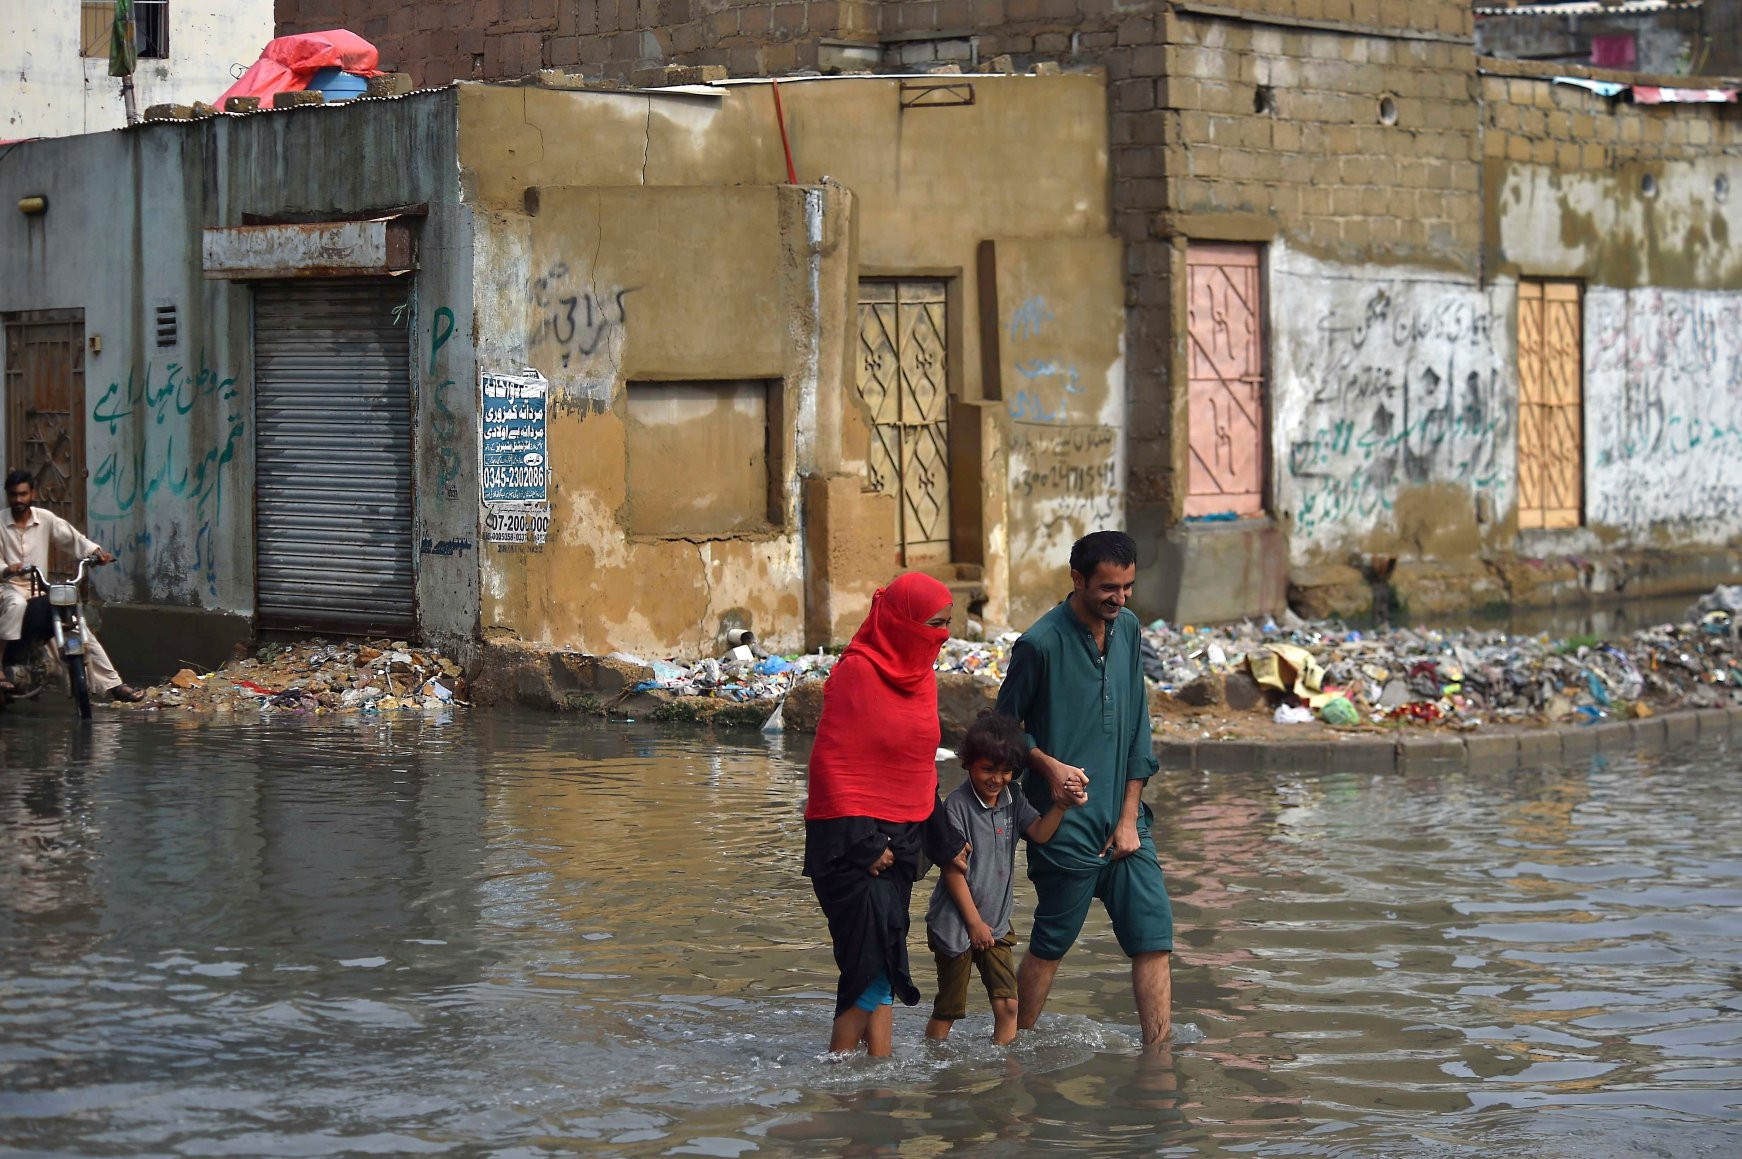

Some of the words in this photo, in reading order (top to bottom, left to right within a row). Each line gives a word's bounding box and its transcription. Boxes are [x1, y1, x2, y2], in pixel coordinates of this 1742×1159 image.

[485, 404, 517, 423] کمزوری
[519, 404, 543, 423] مردانہ
[484, 425, 508, 440] اولادی
[521, 425, 544, 440] مردانہ
[484, 467, 544, 488] 0345-2302086
